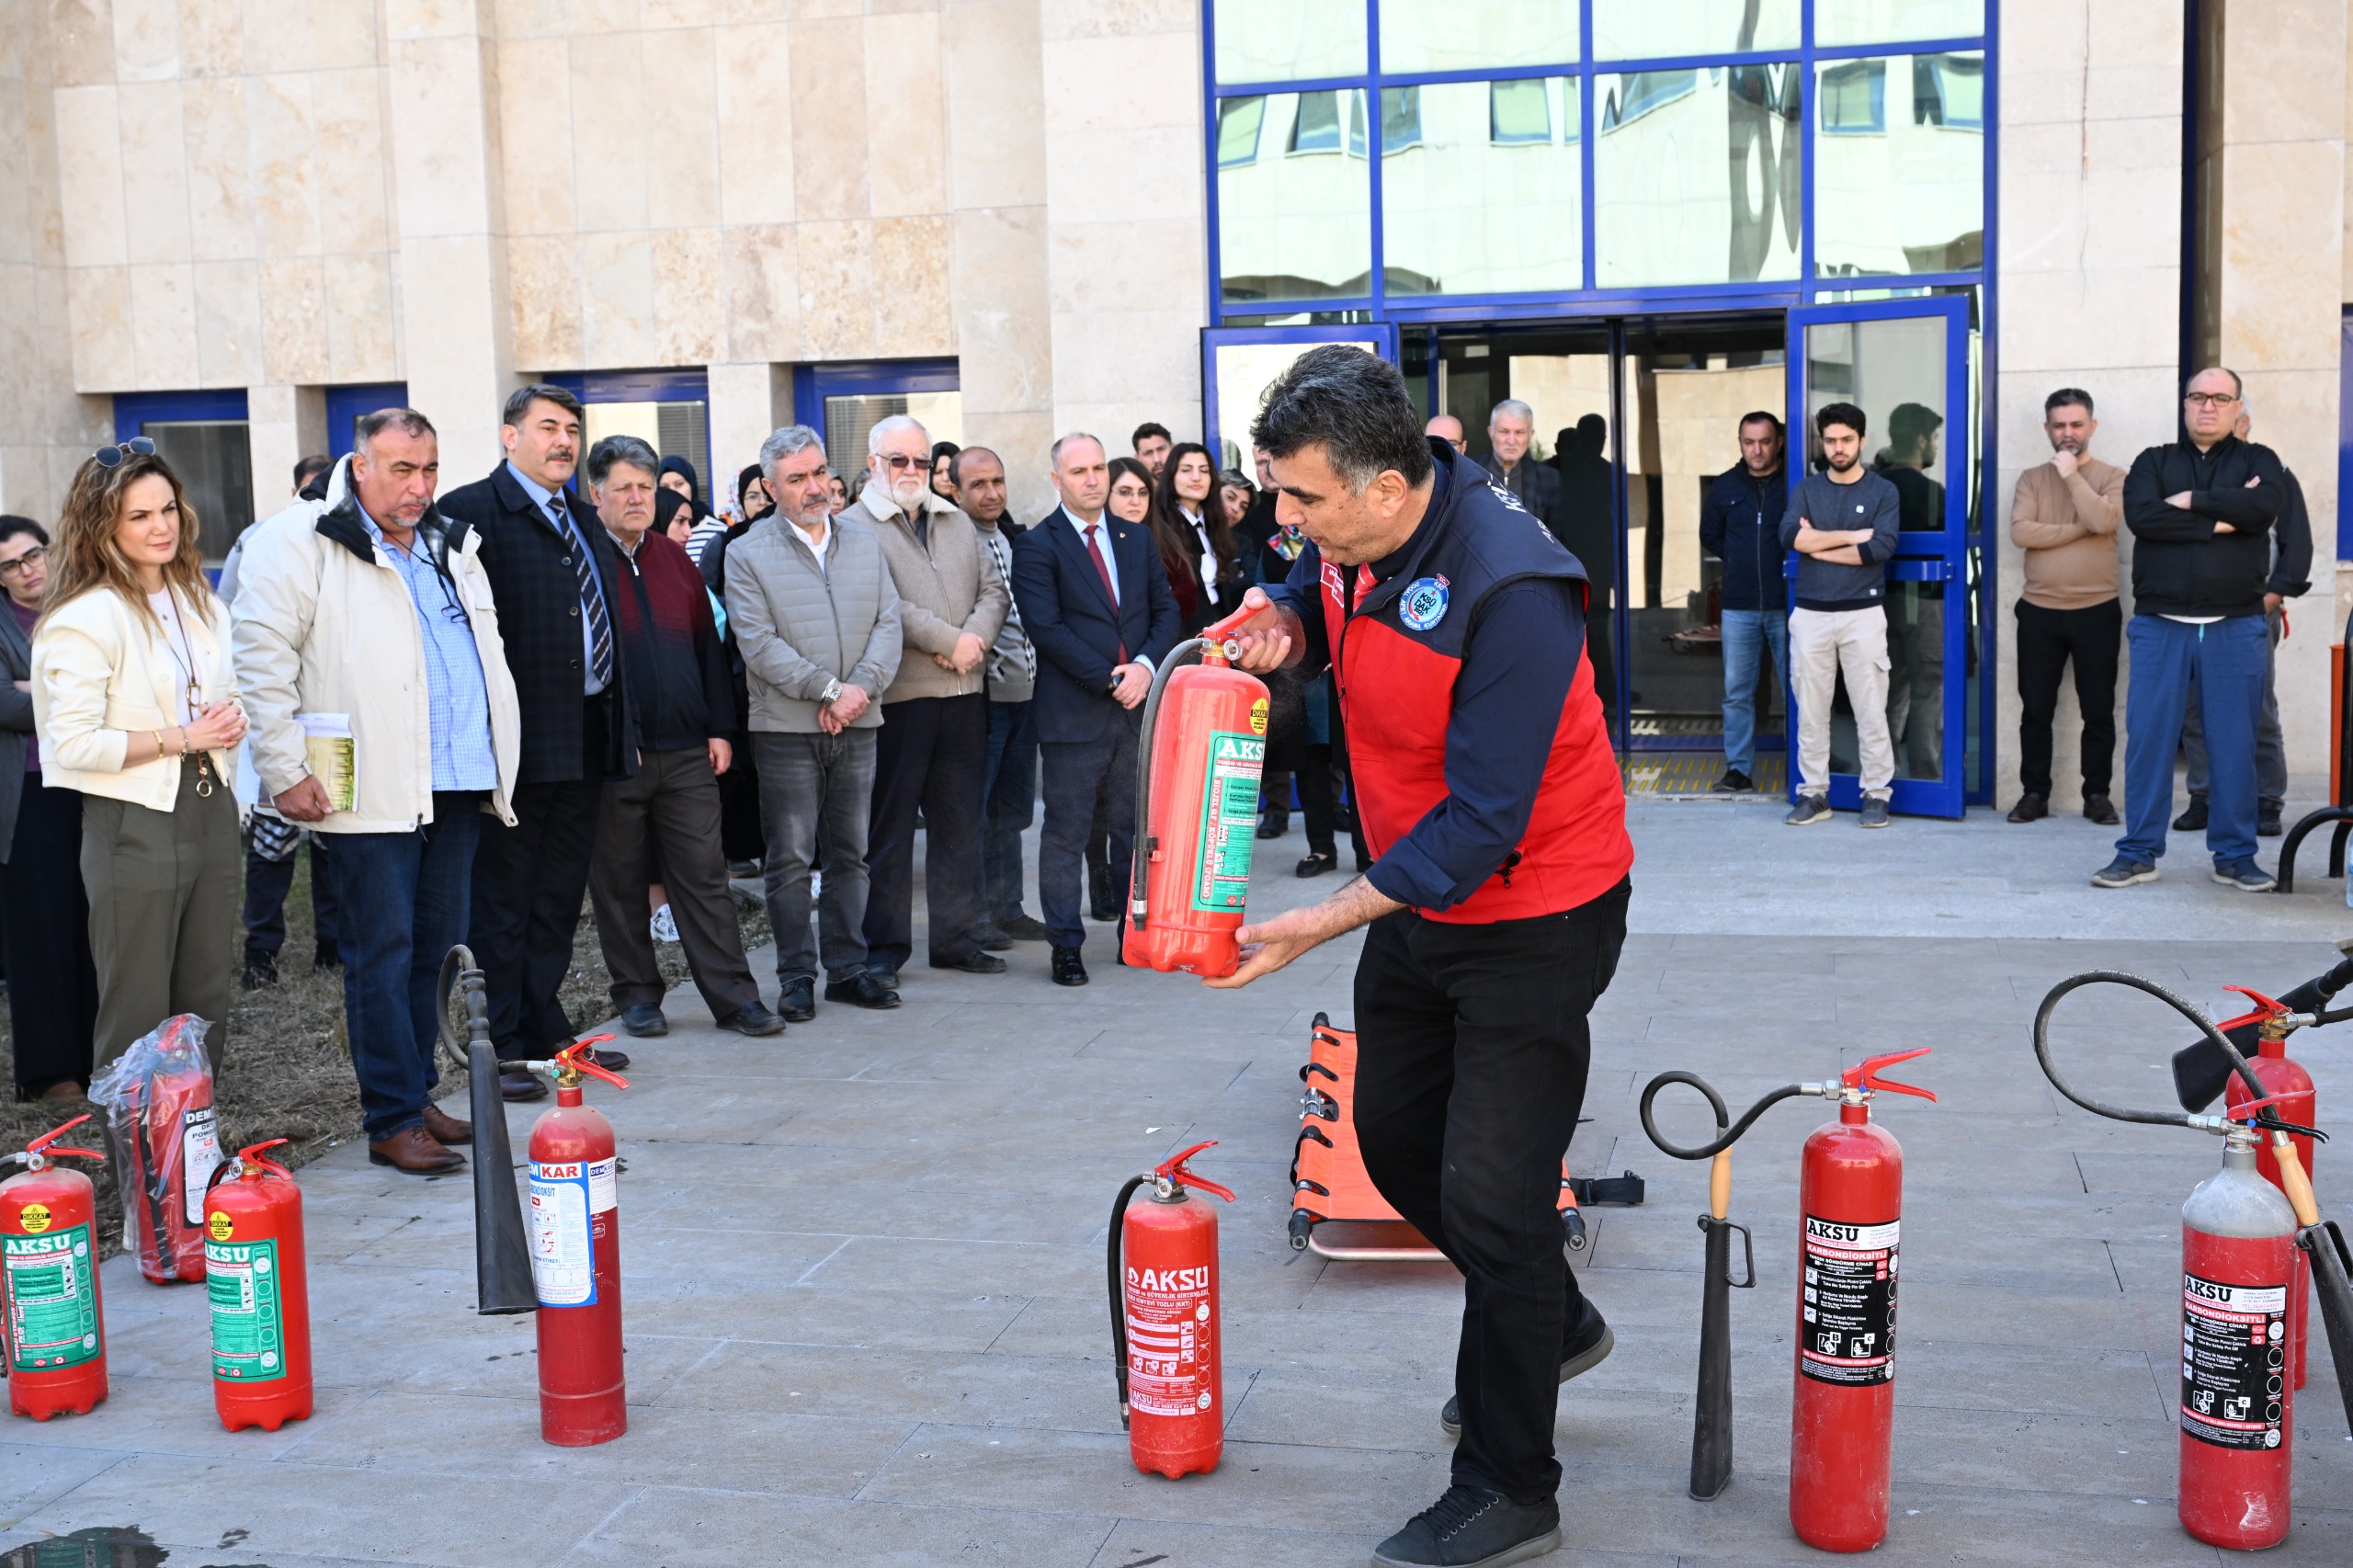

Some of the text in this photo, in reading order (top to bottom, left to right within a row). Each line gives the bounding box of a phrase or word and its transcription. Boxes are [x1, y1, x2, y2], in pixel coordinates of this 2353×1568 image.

[1414, 598, 1431, 614] DAK
[1218, 739, 1265, 761] AKS
[186, 1108, 213, 1123] DEM
[192, 1130, 213, 1138] POWD
[541, 1165, 578, 1178] KAR
[1807, 1220, 1859, 1242] AKSU
[6, 1233, 71, 1255] AKSU
[1807, 1244, 1888, 1260] KARBONDİOKSİTLİ
[1825, 1258, 1855, 1267] SÖNDÜRME
[1141, 1266, 1208, 1291] AKSU
[1147, 1290, 1176, 1299] GÜVENLİK
[1176, 1287, 1209, 1299] SİSTEMLERİ
[2186, 1277, 2232, 1302] AKSU
[1136, 1296, 1155, 1306] KİMYEVİ
[2185, 1301, 2265, 1323] KARBONDİOKSİTLİ
[2229, 1320, 2248, 1329] CİHAZI
[2206, 1392, 2213, 1401] B
